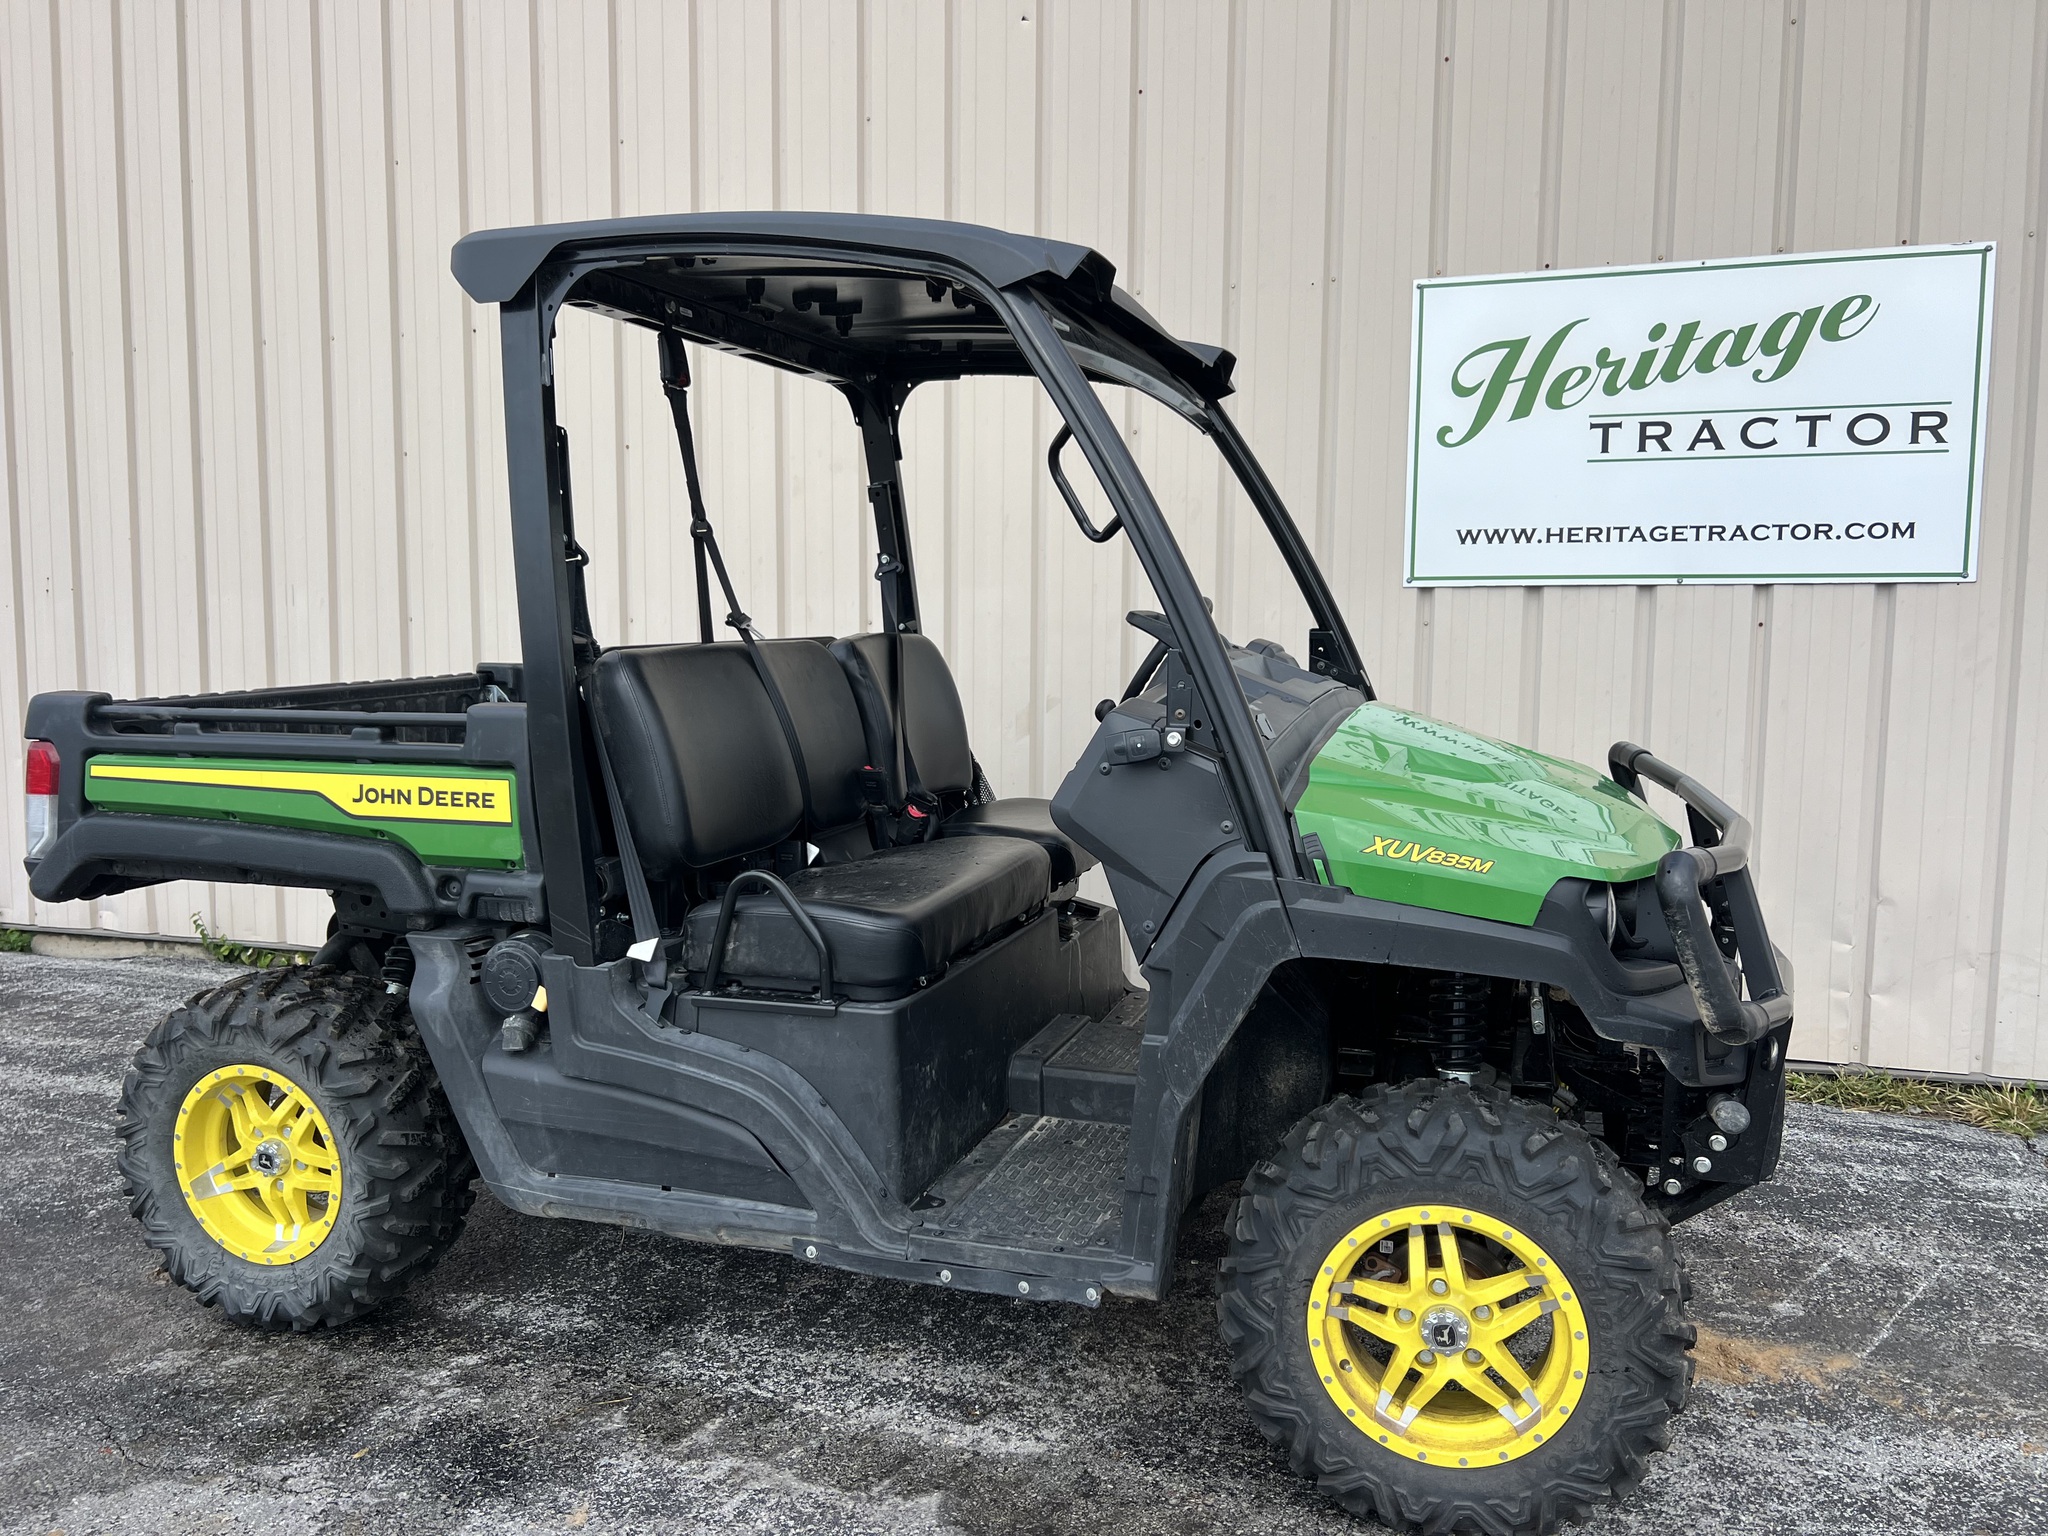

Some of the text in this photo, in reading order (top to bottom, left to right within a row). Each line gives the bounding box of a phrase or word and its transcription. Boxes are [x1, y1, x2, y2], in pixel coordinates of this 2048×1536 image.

[1436, 294, 1881, 449] Heritage
[1589, 410, 1950, 454] TRACTOR
[1456, 521, 1916, 545] WWW.HERITAGETRACTOR.COM
[352, 784, 495, 809] JOHN DEERE
[1360, 834, 1496, 874] XUV835M
